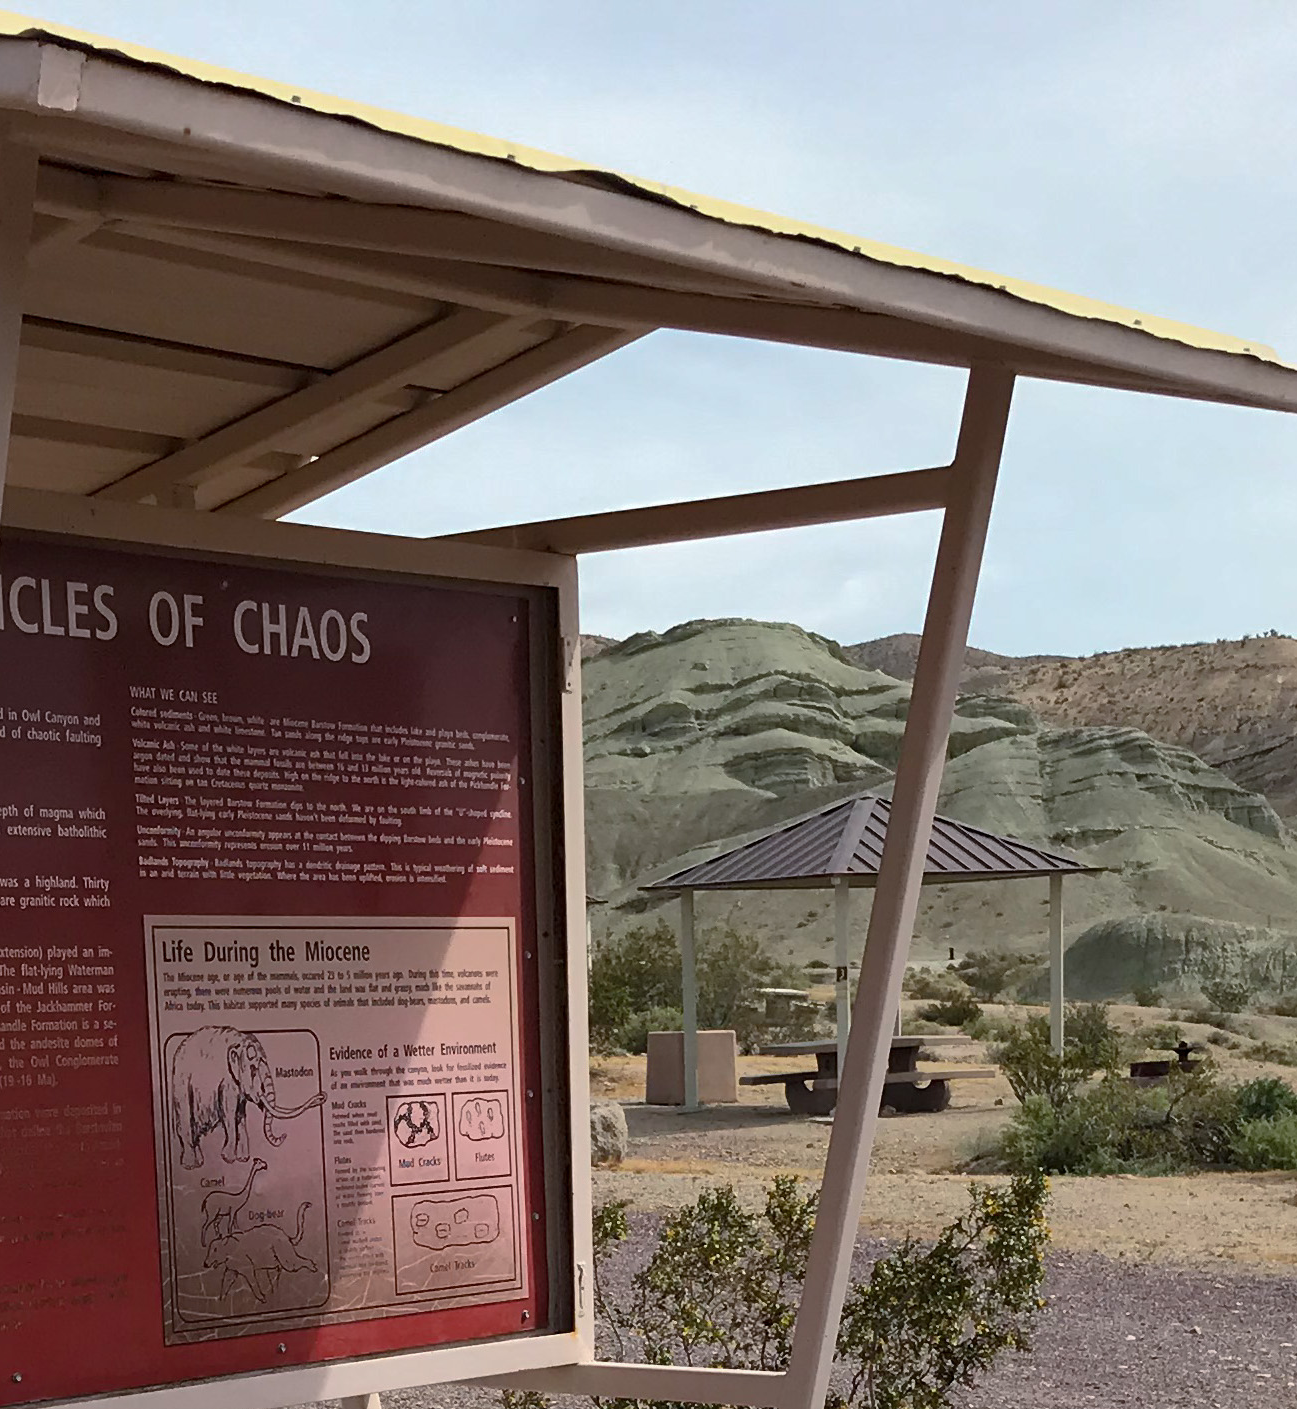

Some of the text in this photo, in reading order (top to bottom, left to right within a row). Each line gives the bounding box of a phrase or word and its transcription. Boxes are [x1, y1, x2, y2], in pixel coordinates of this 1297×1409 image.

[149, 590, 203, 648] OF
[233, 600, 371, 664] CHAOS
[130, 686, 217, 704] WHAT WE CAN SEE
[163, 940, 369, 968] Life During the Miocene
[330, 1042, 496, 1060] Evidence of a Wetter Environment
[276, 1066, 313, 1079] Mastodon
[419, 1156, 441, 1168] Cracks
[475, 1152, 495, 1162] Flutes
[200, 1175, 225, 1188] Camel
